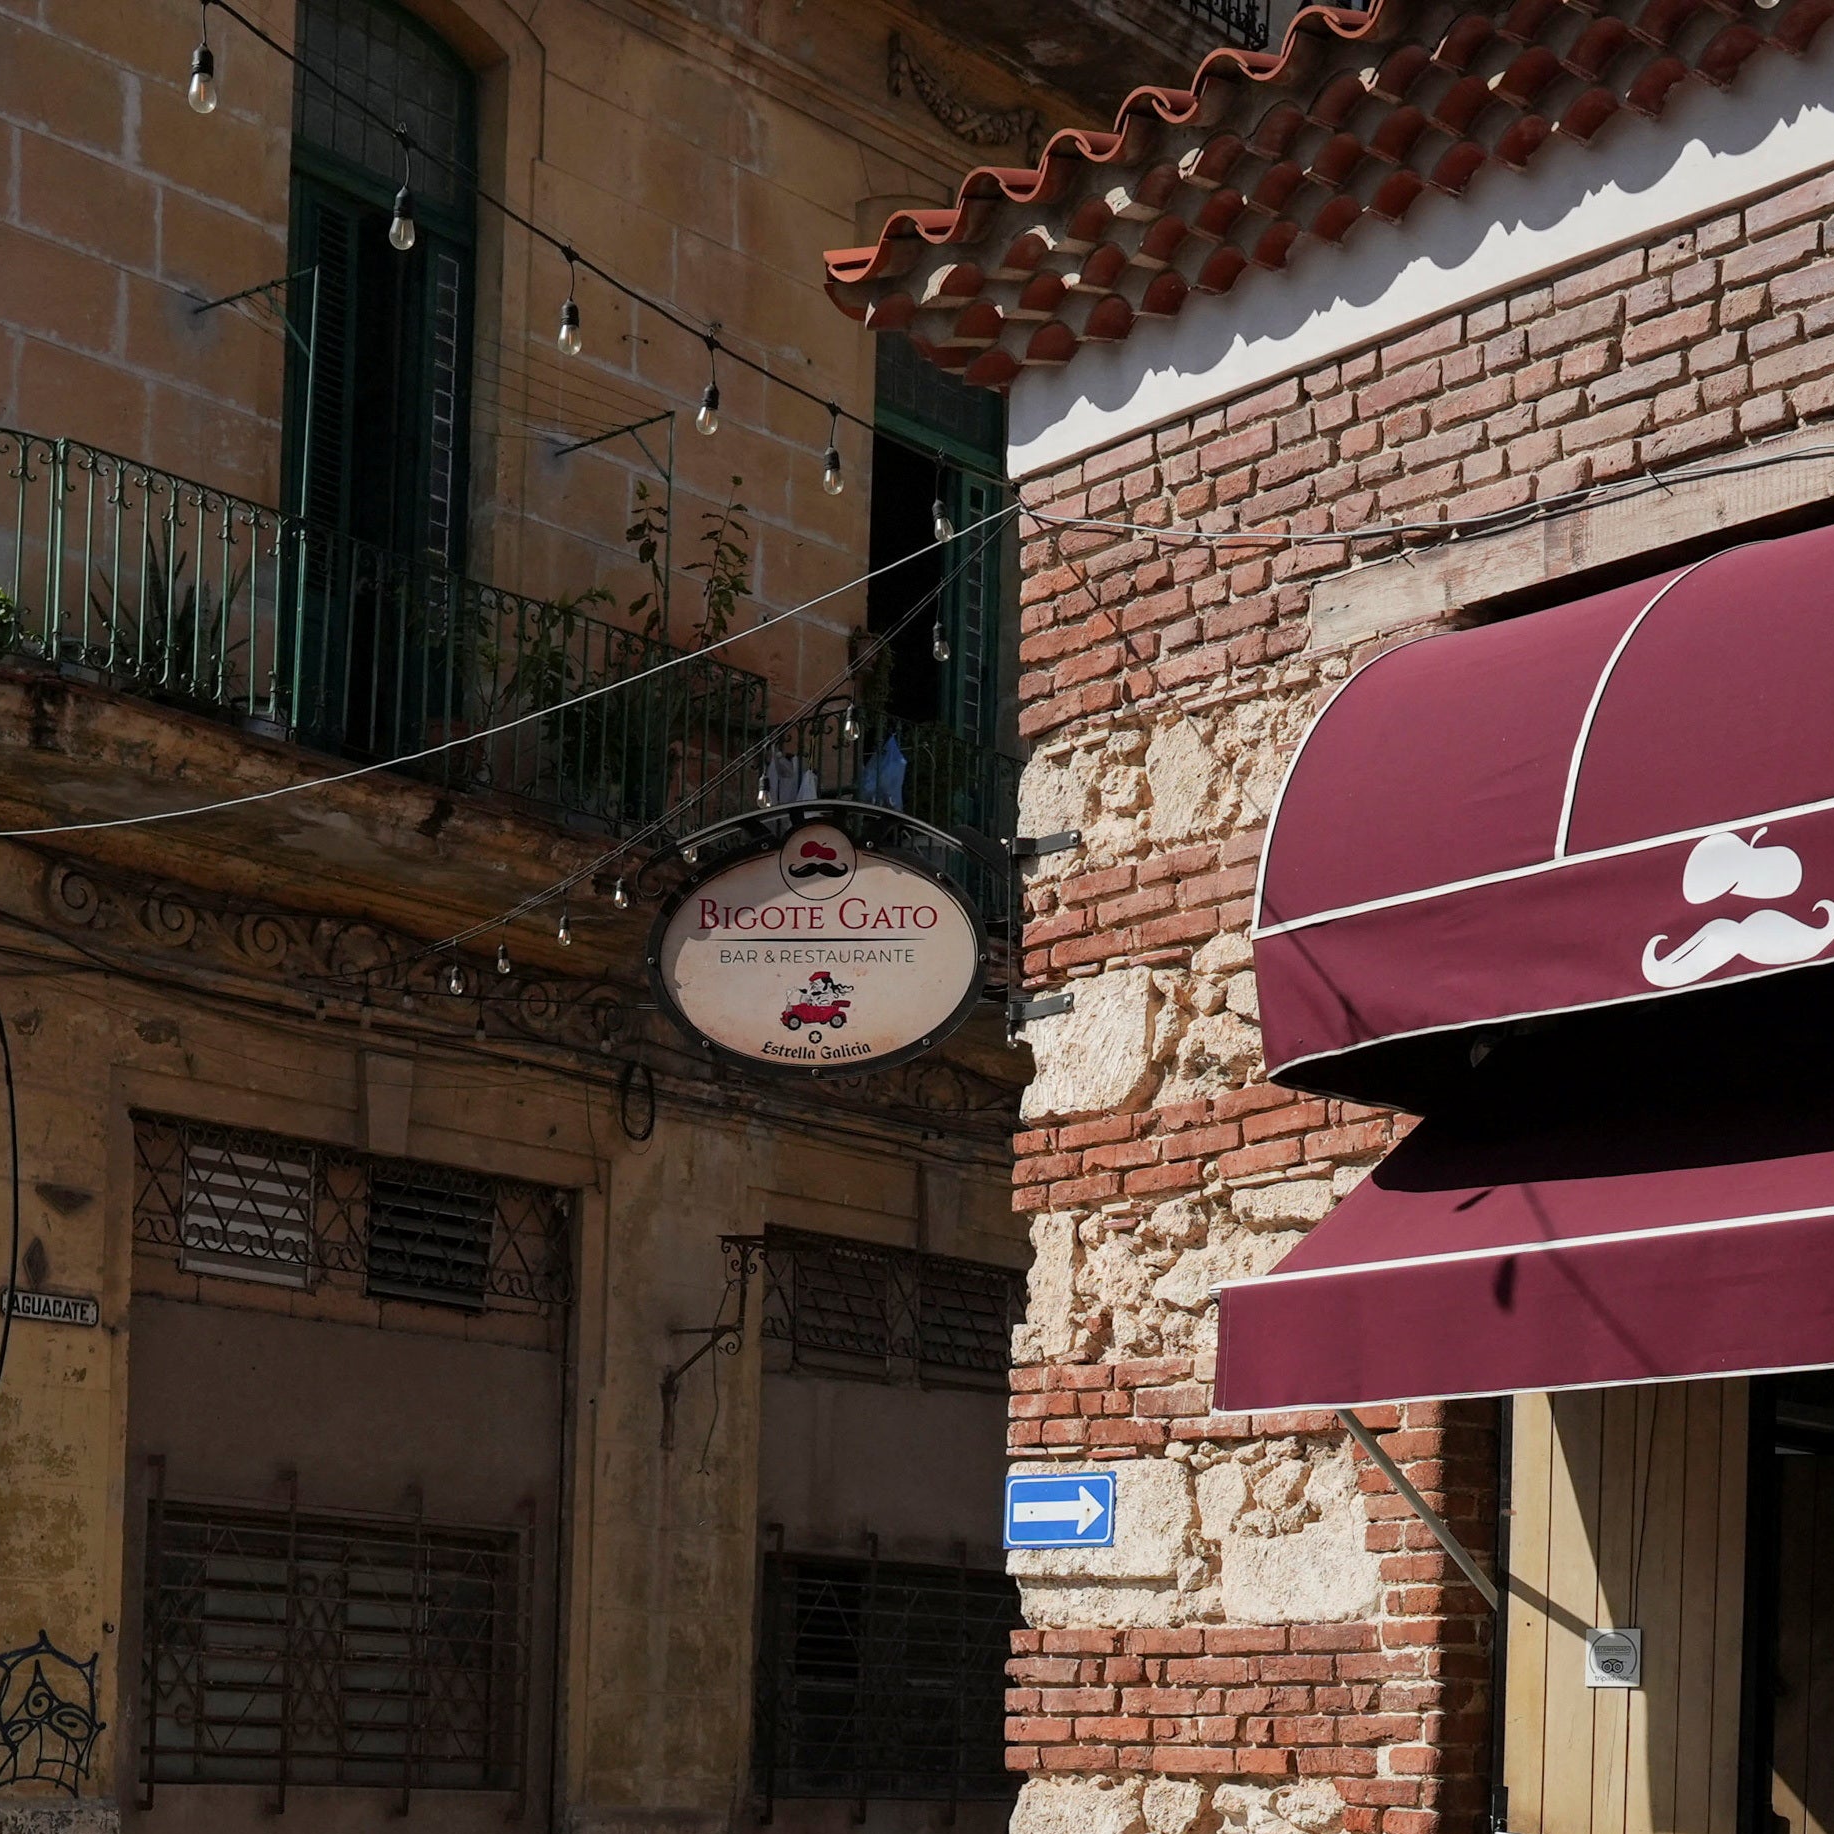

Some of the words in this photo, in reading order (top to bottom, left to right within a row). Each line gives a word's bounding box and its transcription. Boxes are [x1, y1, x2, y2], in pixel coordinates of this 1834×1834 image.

[698, 898, 824, 930] BIGOTE
[838, 897, 938, 929] GATO
[720, 949, 757, 964] BAR
[764, 949, 777, 964] &
[781, 949, 915, 964] RESTAURANTE
[760, 1041, 816, 1060] Estrella
[820, 1041, 872, 1060] Galicia
[11, 1294, 90, 1322] AGUACATE
